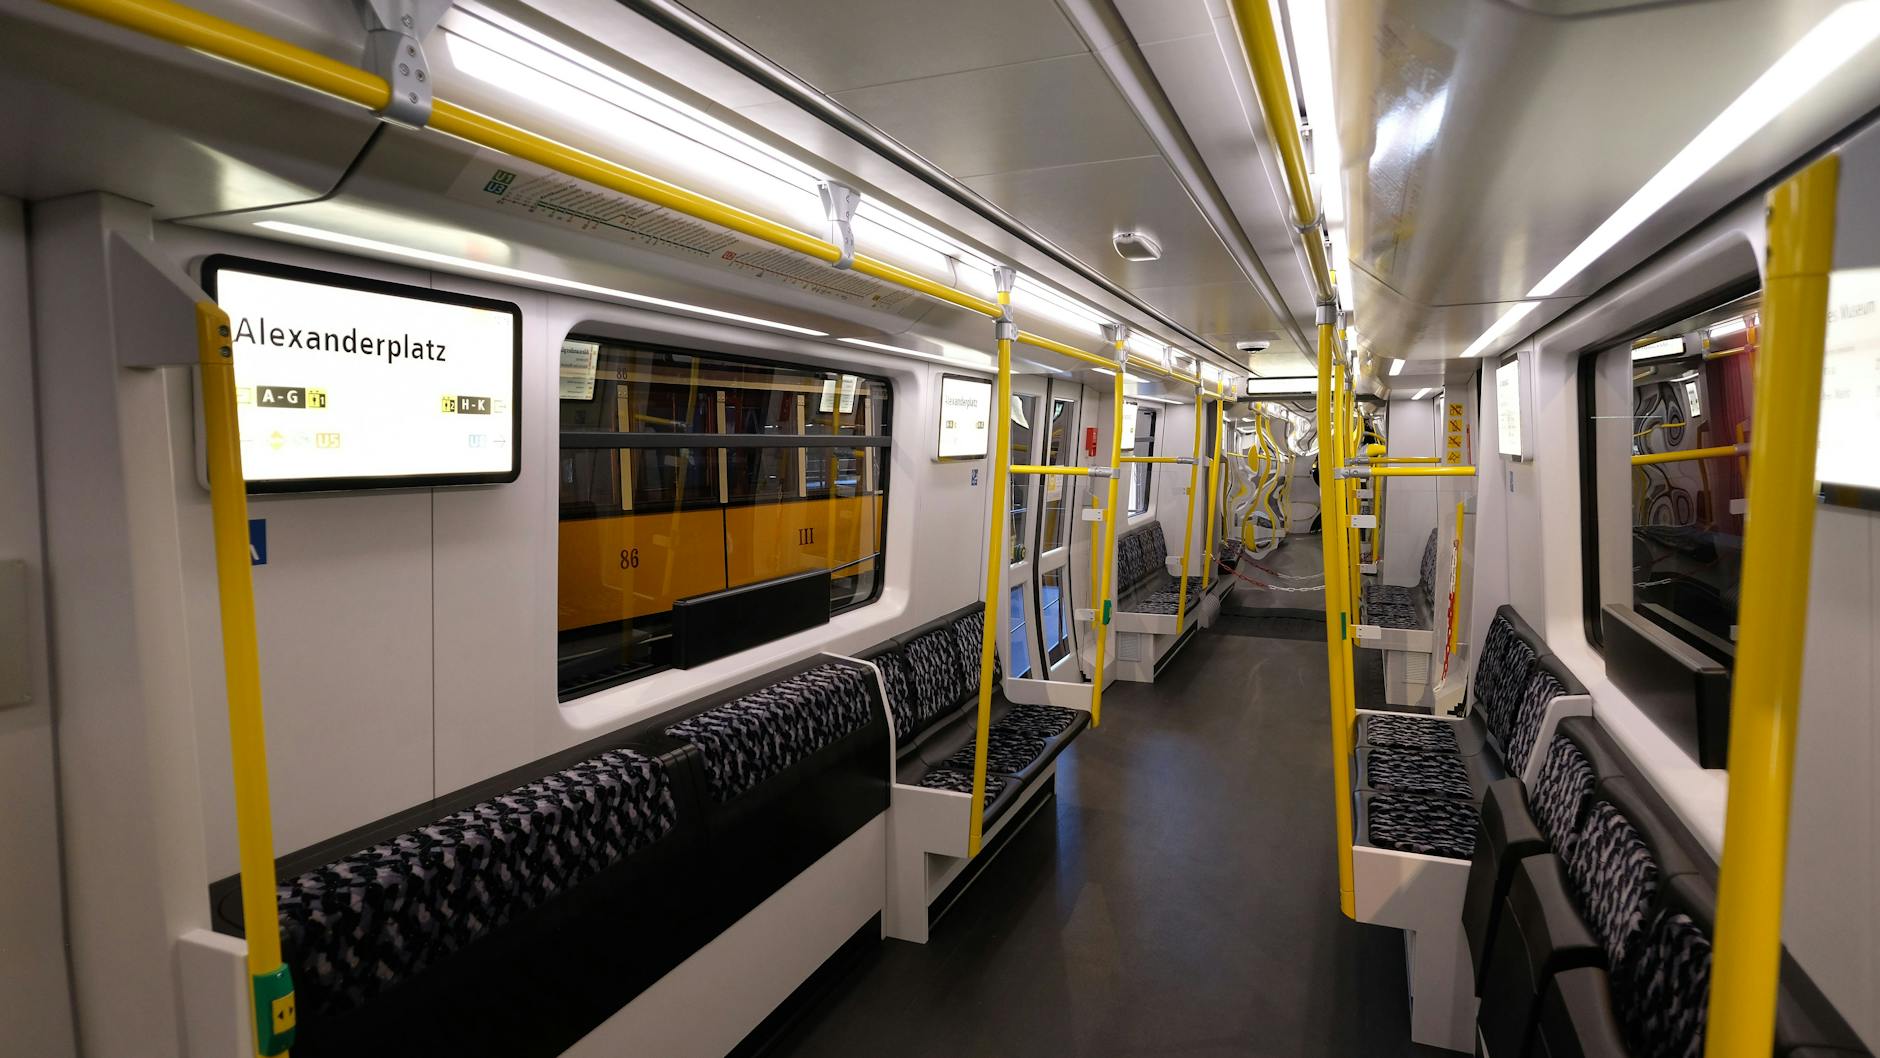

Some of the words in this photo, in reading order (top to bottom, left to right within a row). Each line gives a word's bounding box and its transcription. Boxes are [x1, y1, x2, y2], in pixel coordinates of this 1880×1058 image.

[494, 171, 513, 184] U1
[487, 182, 505, 194] U3
[234, 316, 447, 364] Alexanderplatz
[620, 548, 640, 570] 86
